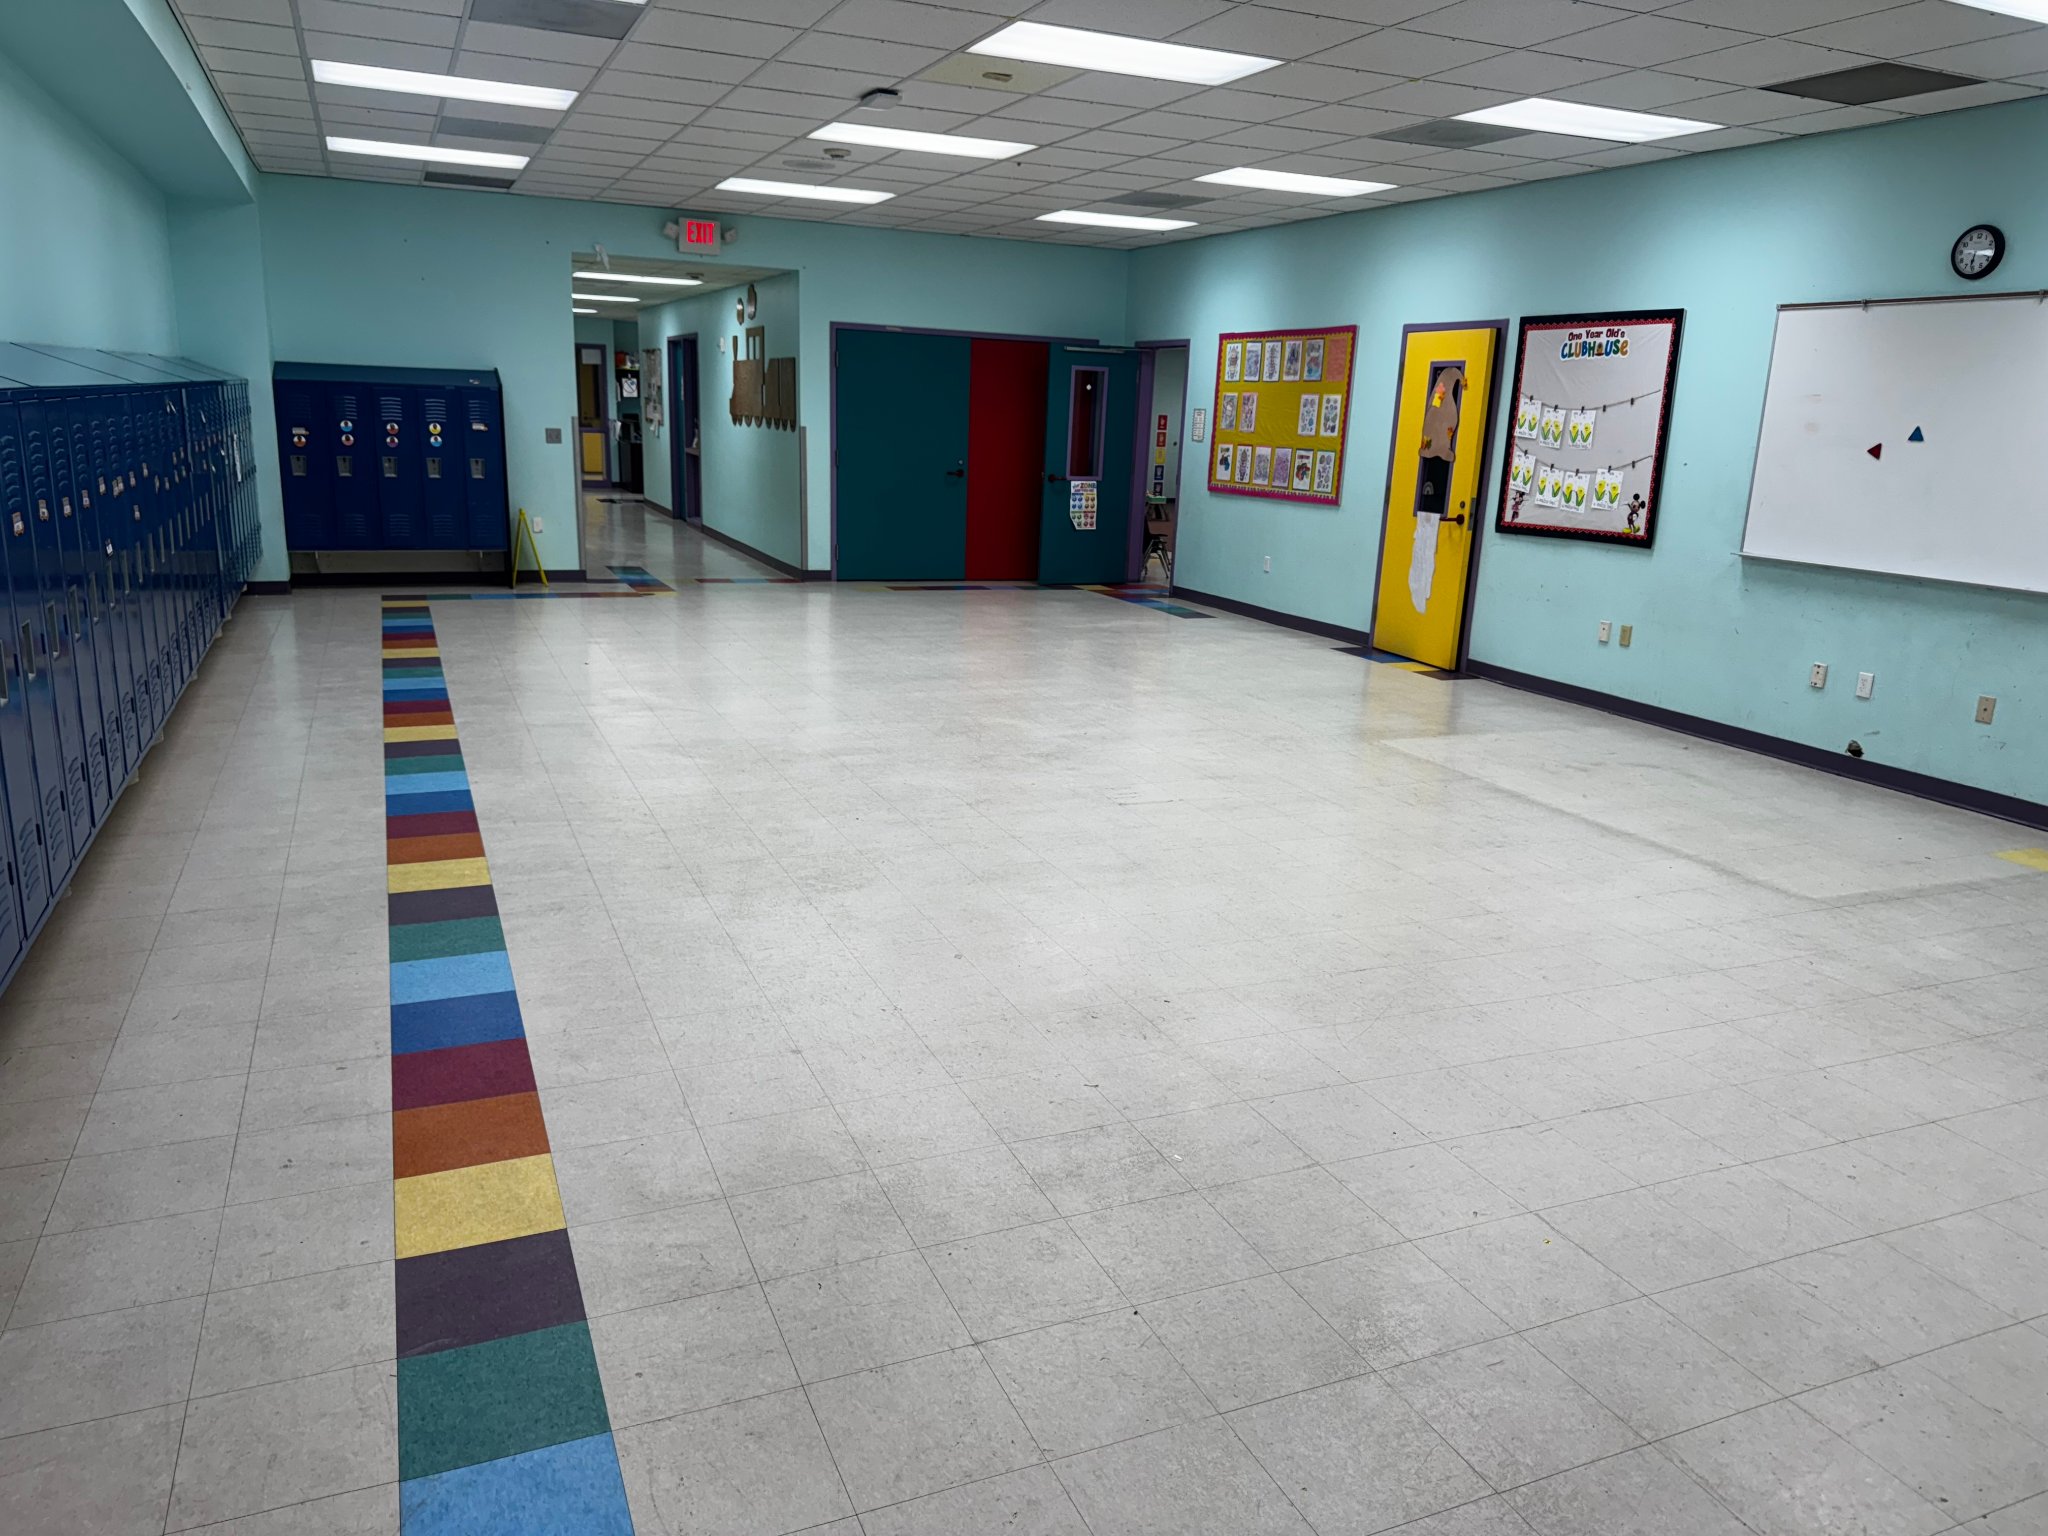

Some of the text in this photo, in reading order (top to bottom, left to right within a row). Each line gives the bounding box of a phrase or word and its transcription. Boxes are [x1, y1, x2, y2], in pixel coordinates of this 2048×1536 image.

[687, 220, 715, 246] EXIT
[1568, 328, 1625, 341] One Year Old's
